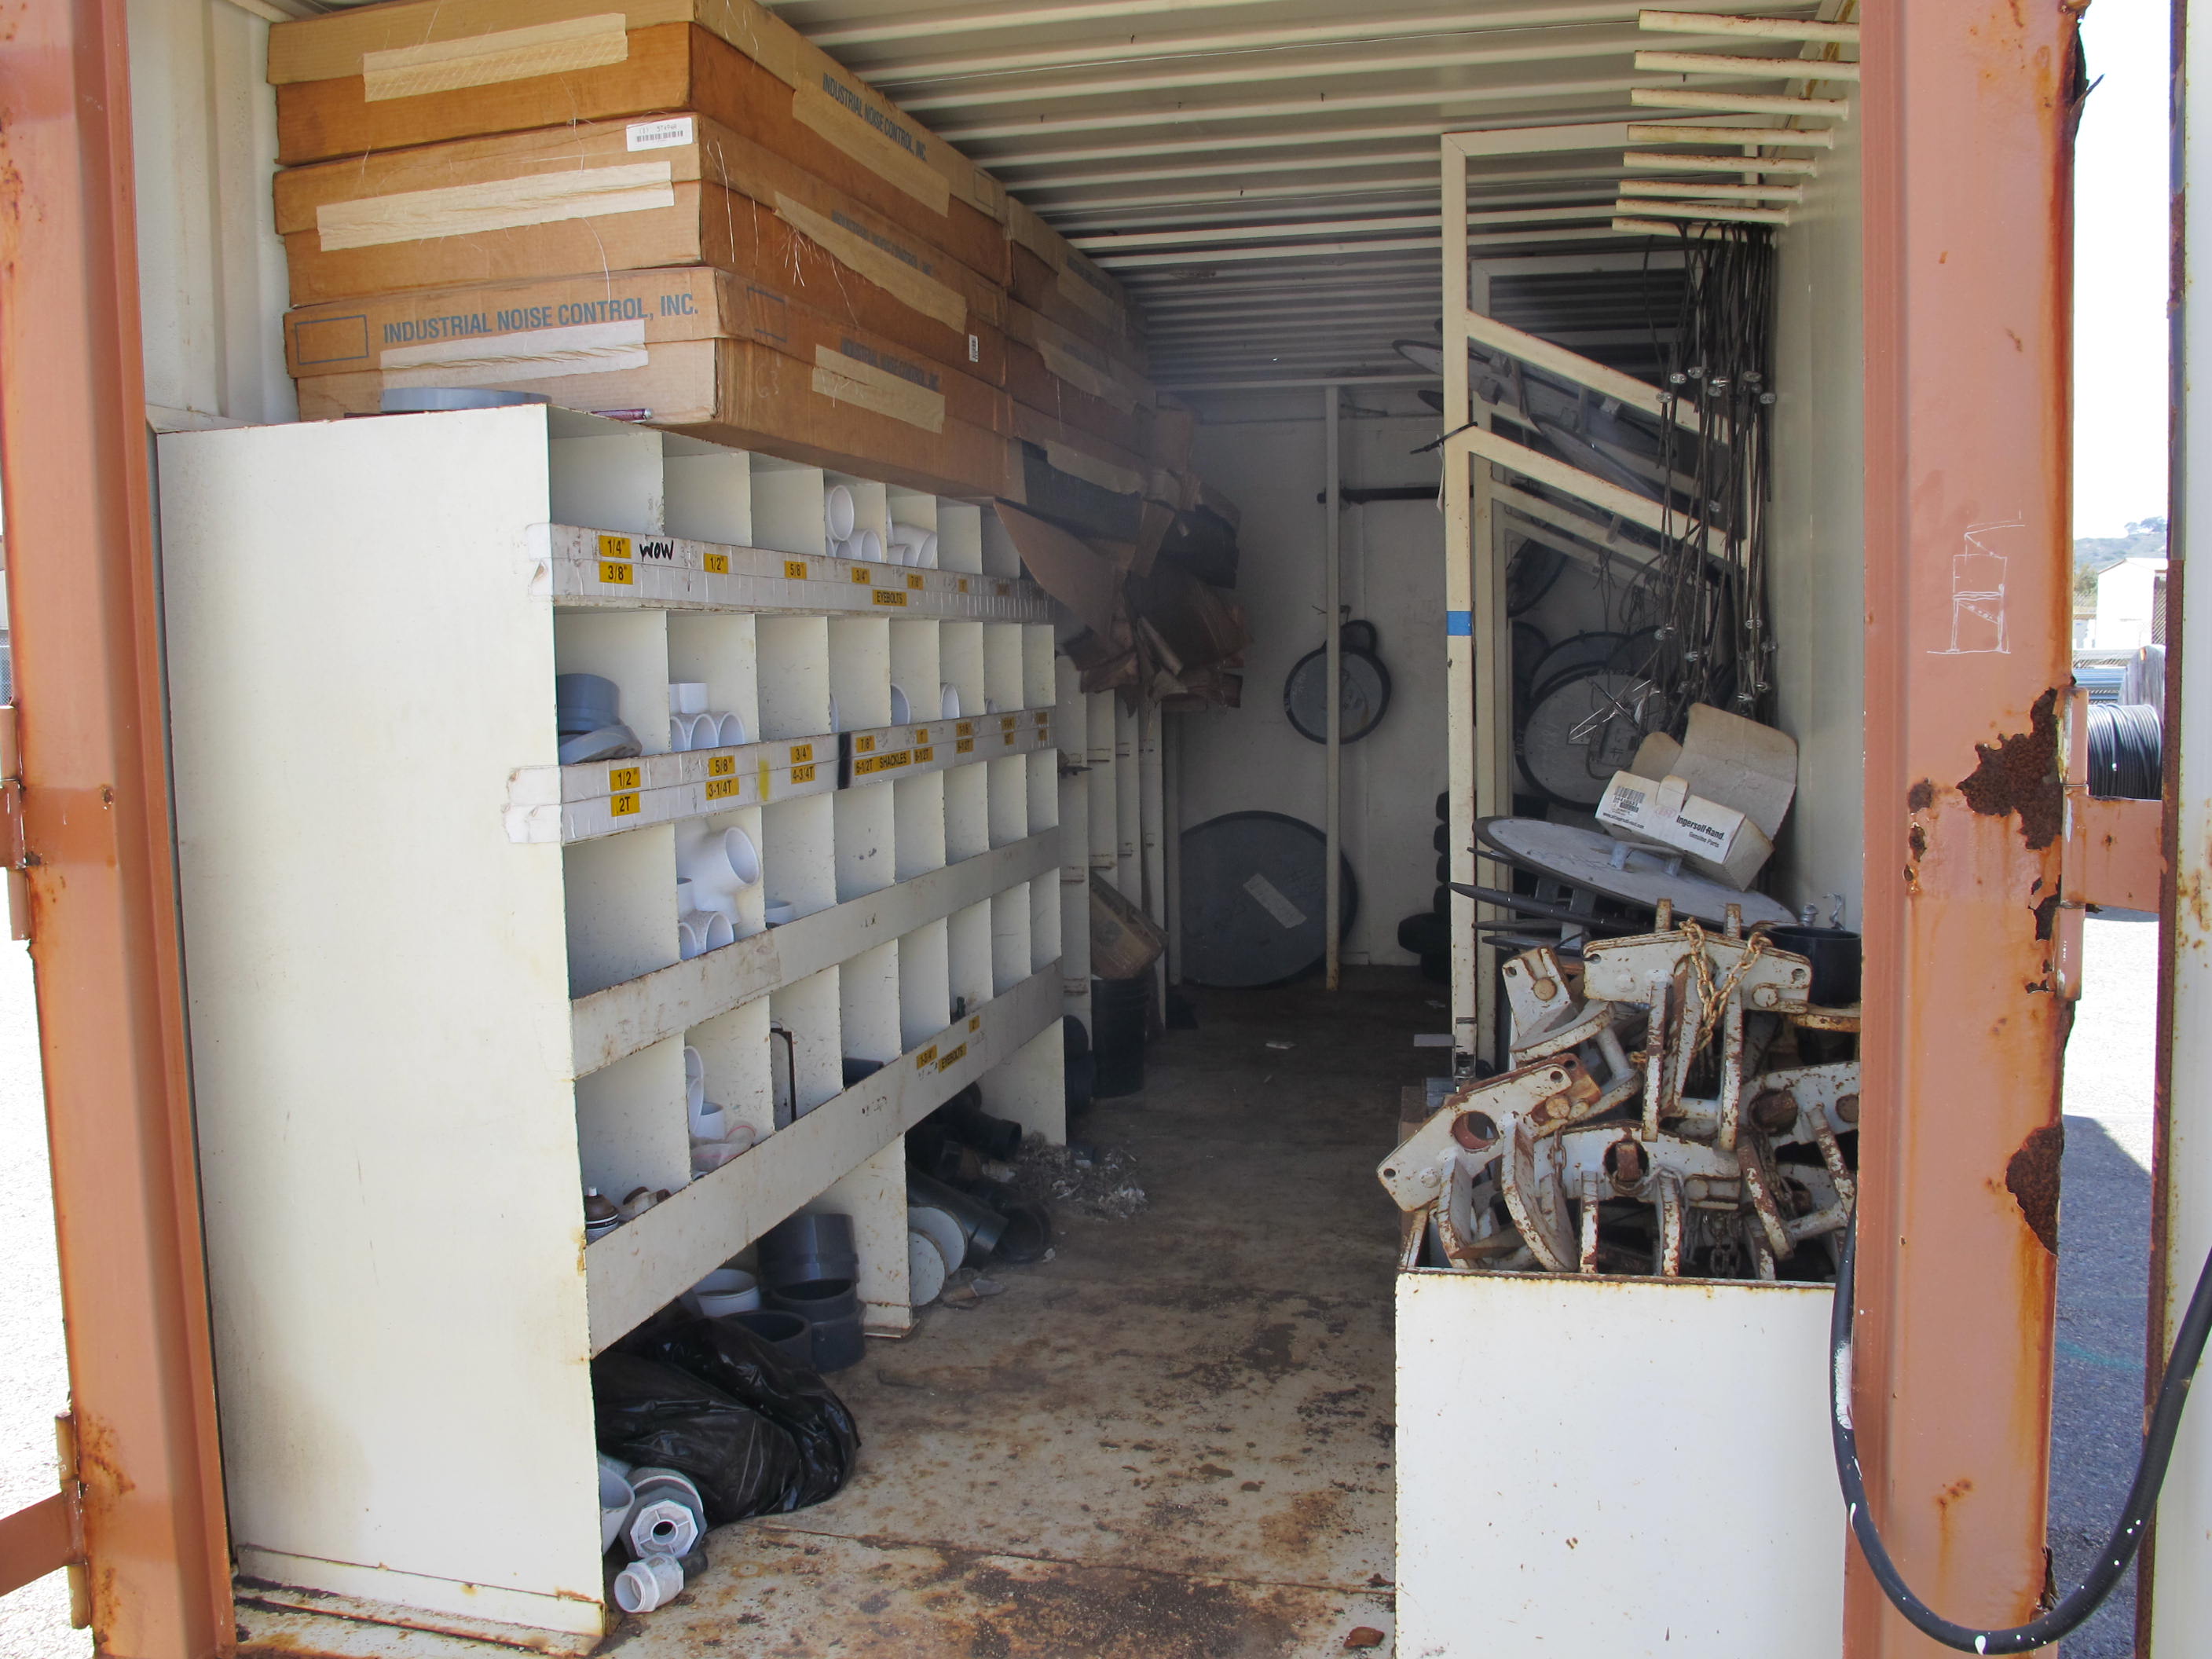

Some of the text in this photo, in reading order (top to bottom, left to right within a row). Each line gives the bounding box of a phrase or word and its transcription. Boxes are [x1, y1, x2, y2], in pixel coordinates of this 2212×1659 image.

[822, 72, 863, 119] INDUSTRIAL
[865, 103, 885, 133] NOISE
[383, 292, 699, 343] INDUSTRIAL NOISE CONTROL, INC.
[876, 591, 904, 605] EYEBOLTS
[879, 752, 907, 769] SHACKLES
[793, 765, 814, 781] 4-3/4T
[709, 780, 732, 797] 3-1/4T
[619, 797, 632, 812] 2T
